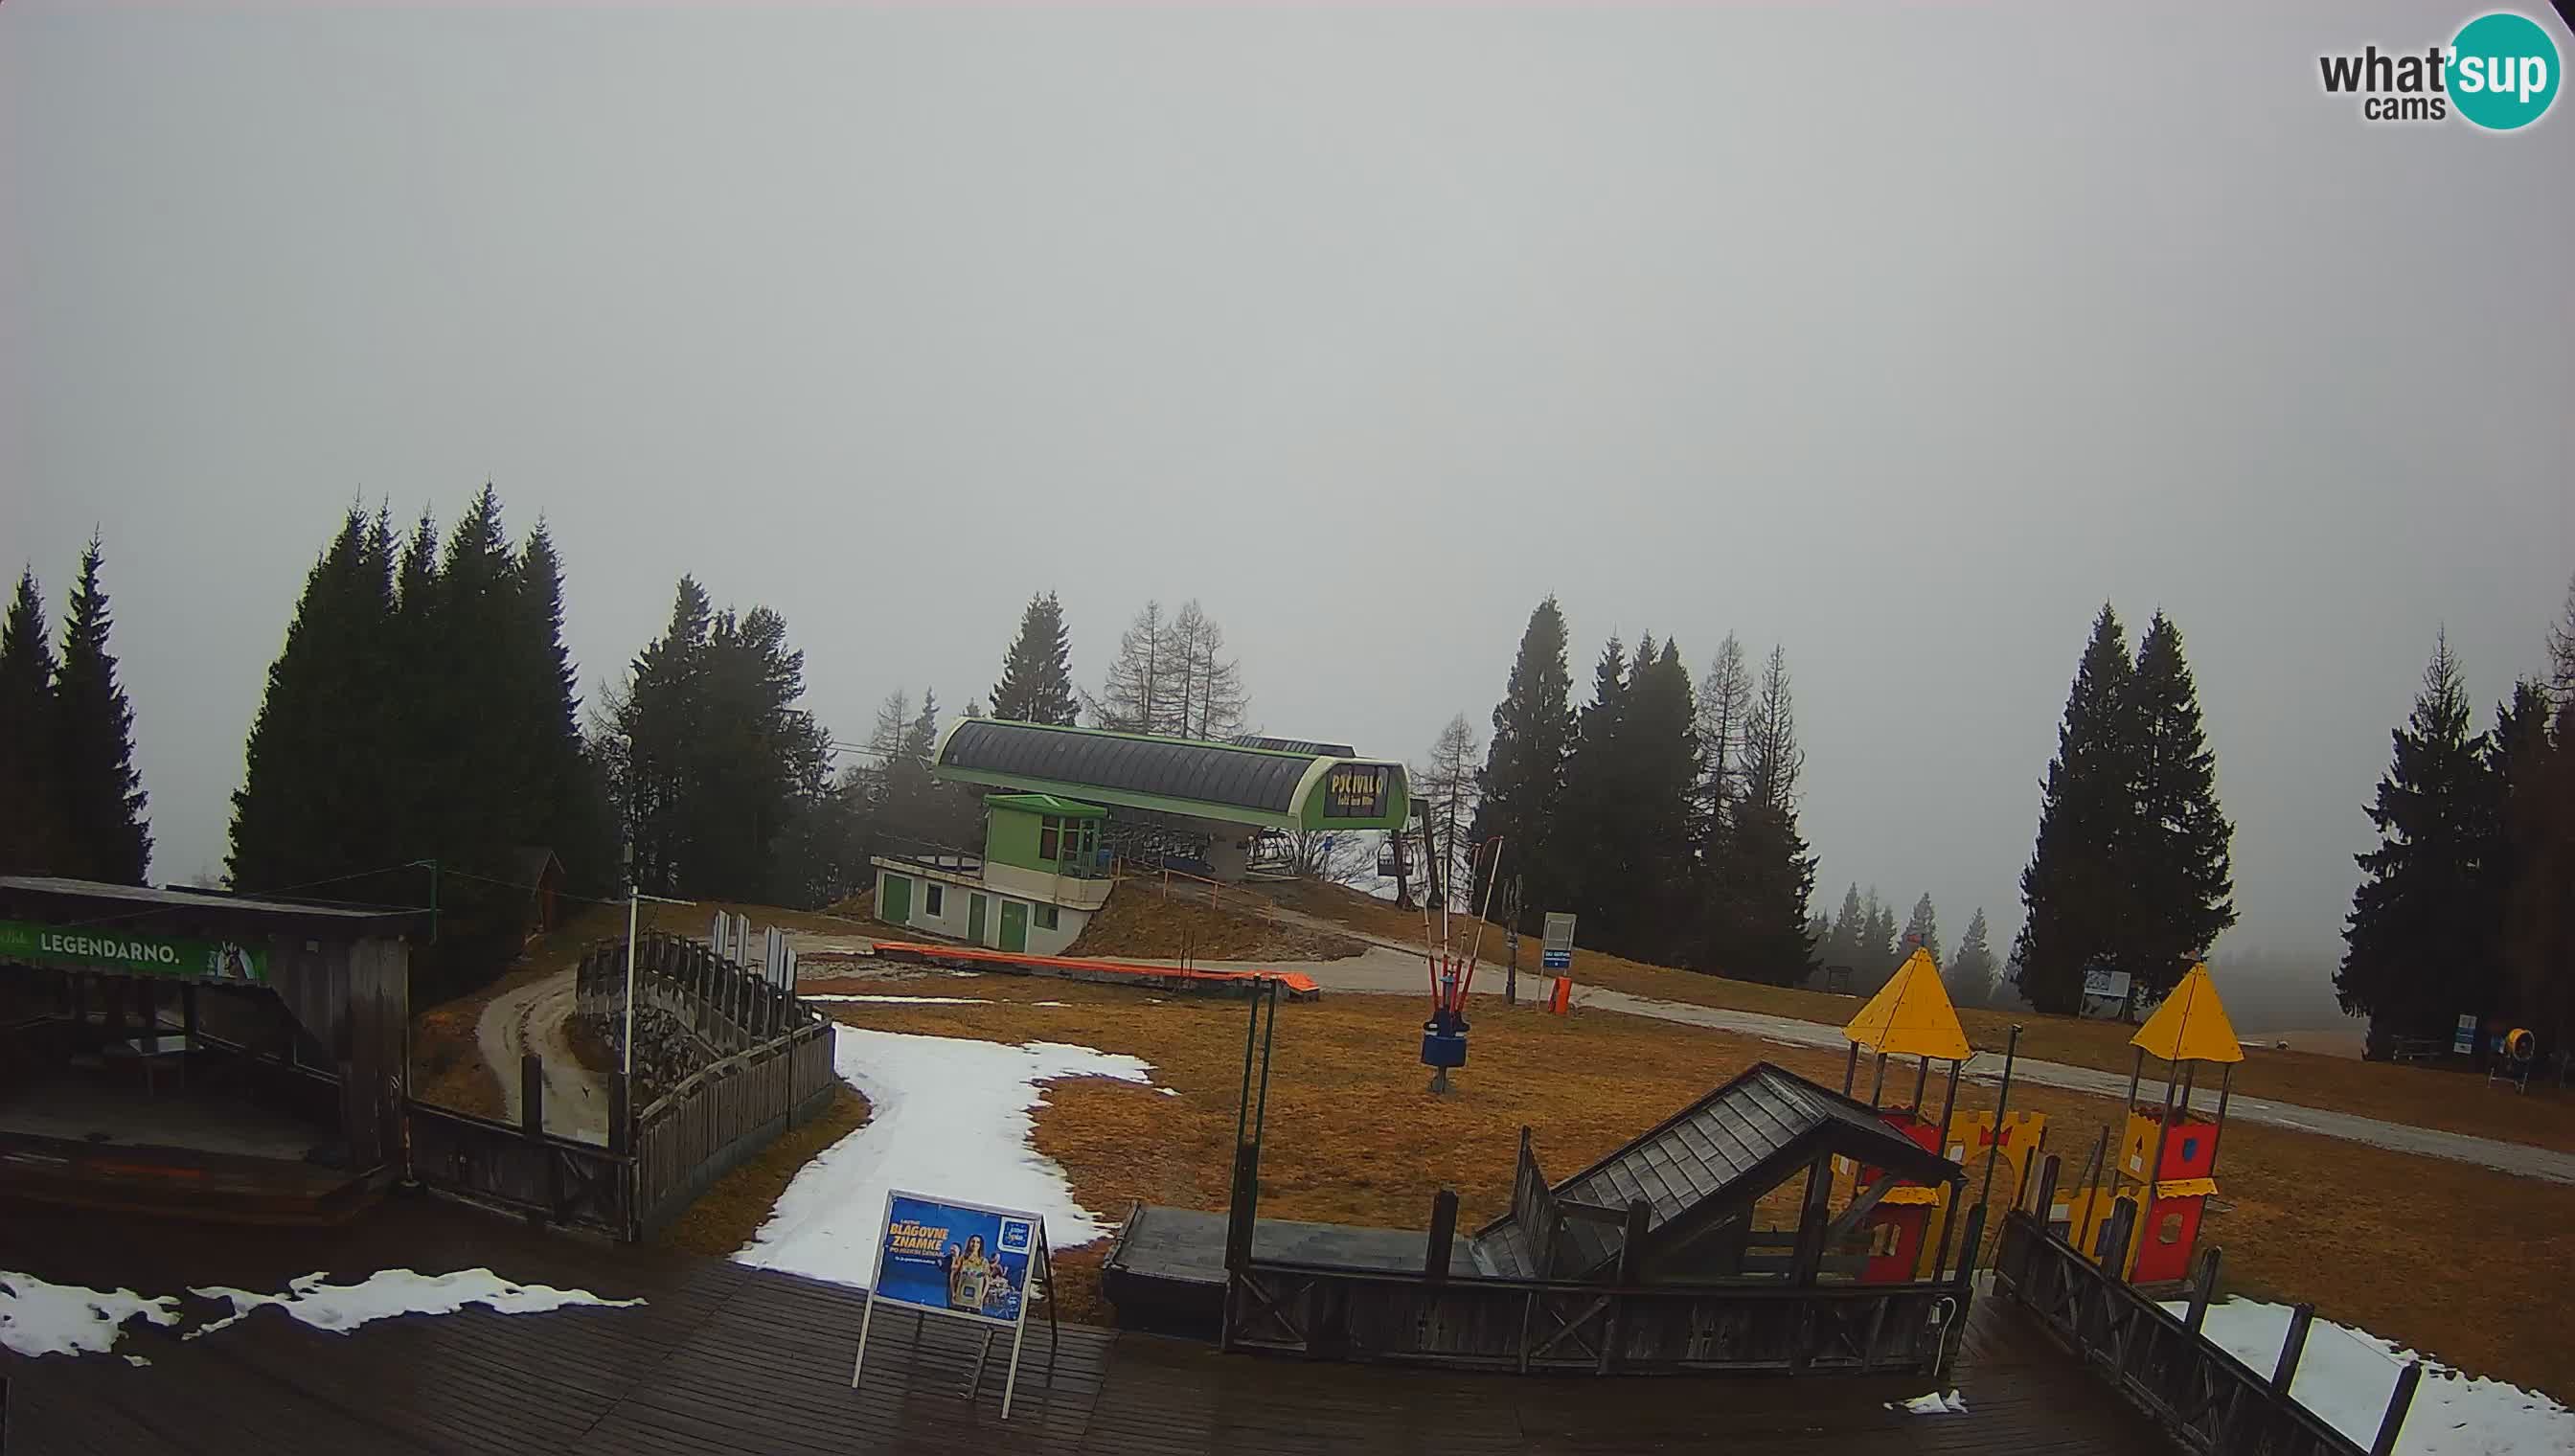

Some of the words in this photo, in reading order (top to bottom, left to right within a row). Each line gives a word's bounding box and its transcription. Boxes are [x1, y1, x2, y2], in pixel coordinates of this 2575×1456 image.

[40, 933, 180, 965] LEGENDARNO.
[890, 1222, 949, 1240] BLAGOVNE
[892, 1236, 944, 1251] ZNAMKE
